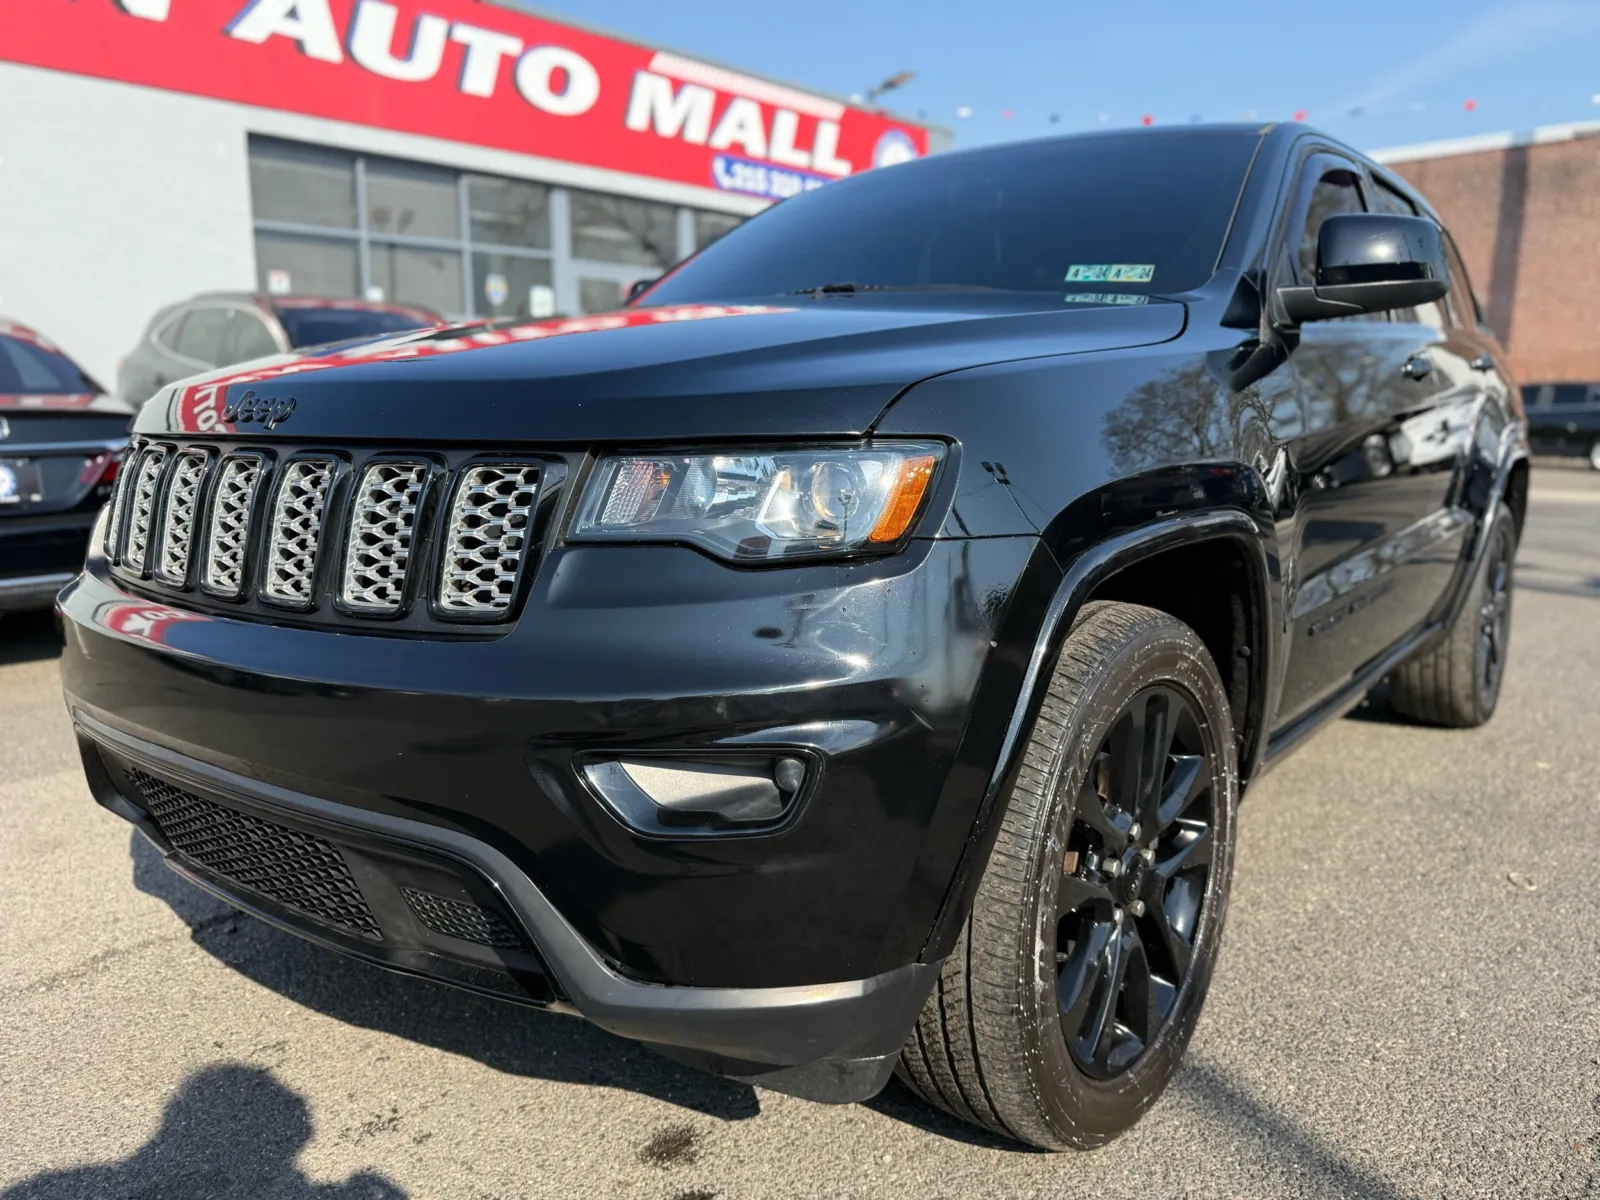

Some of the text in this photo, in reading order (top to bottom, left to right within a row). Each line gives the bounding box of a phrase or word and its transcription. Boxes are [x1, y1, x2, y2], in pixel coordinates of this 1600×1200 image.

[222, 0, 852, 176] AUTO MALL
[221, 389, 297, 430] Jeep
